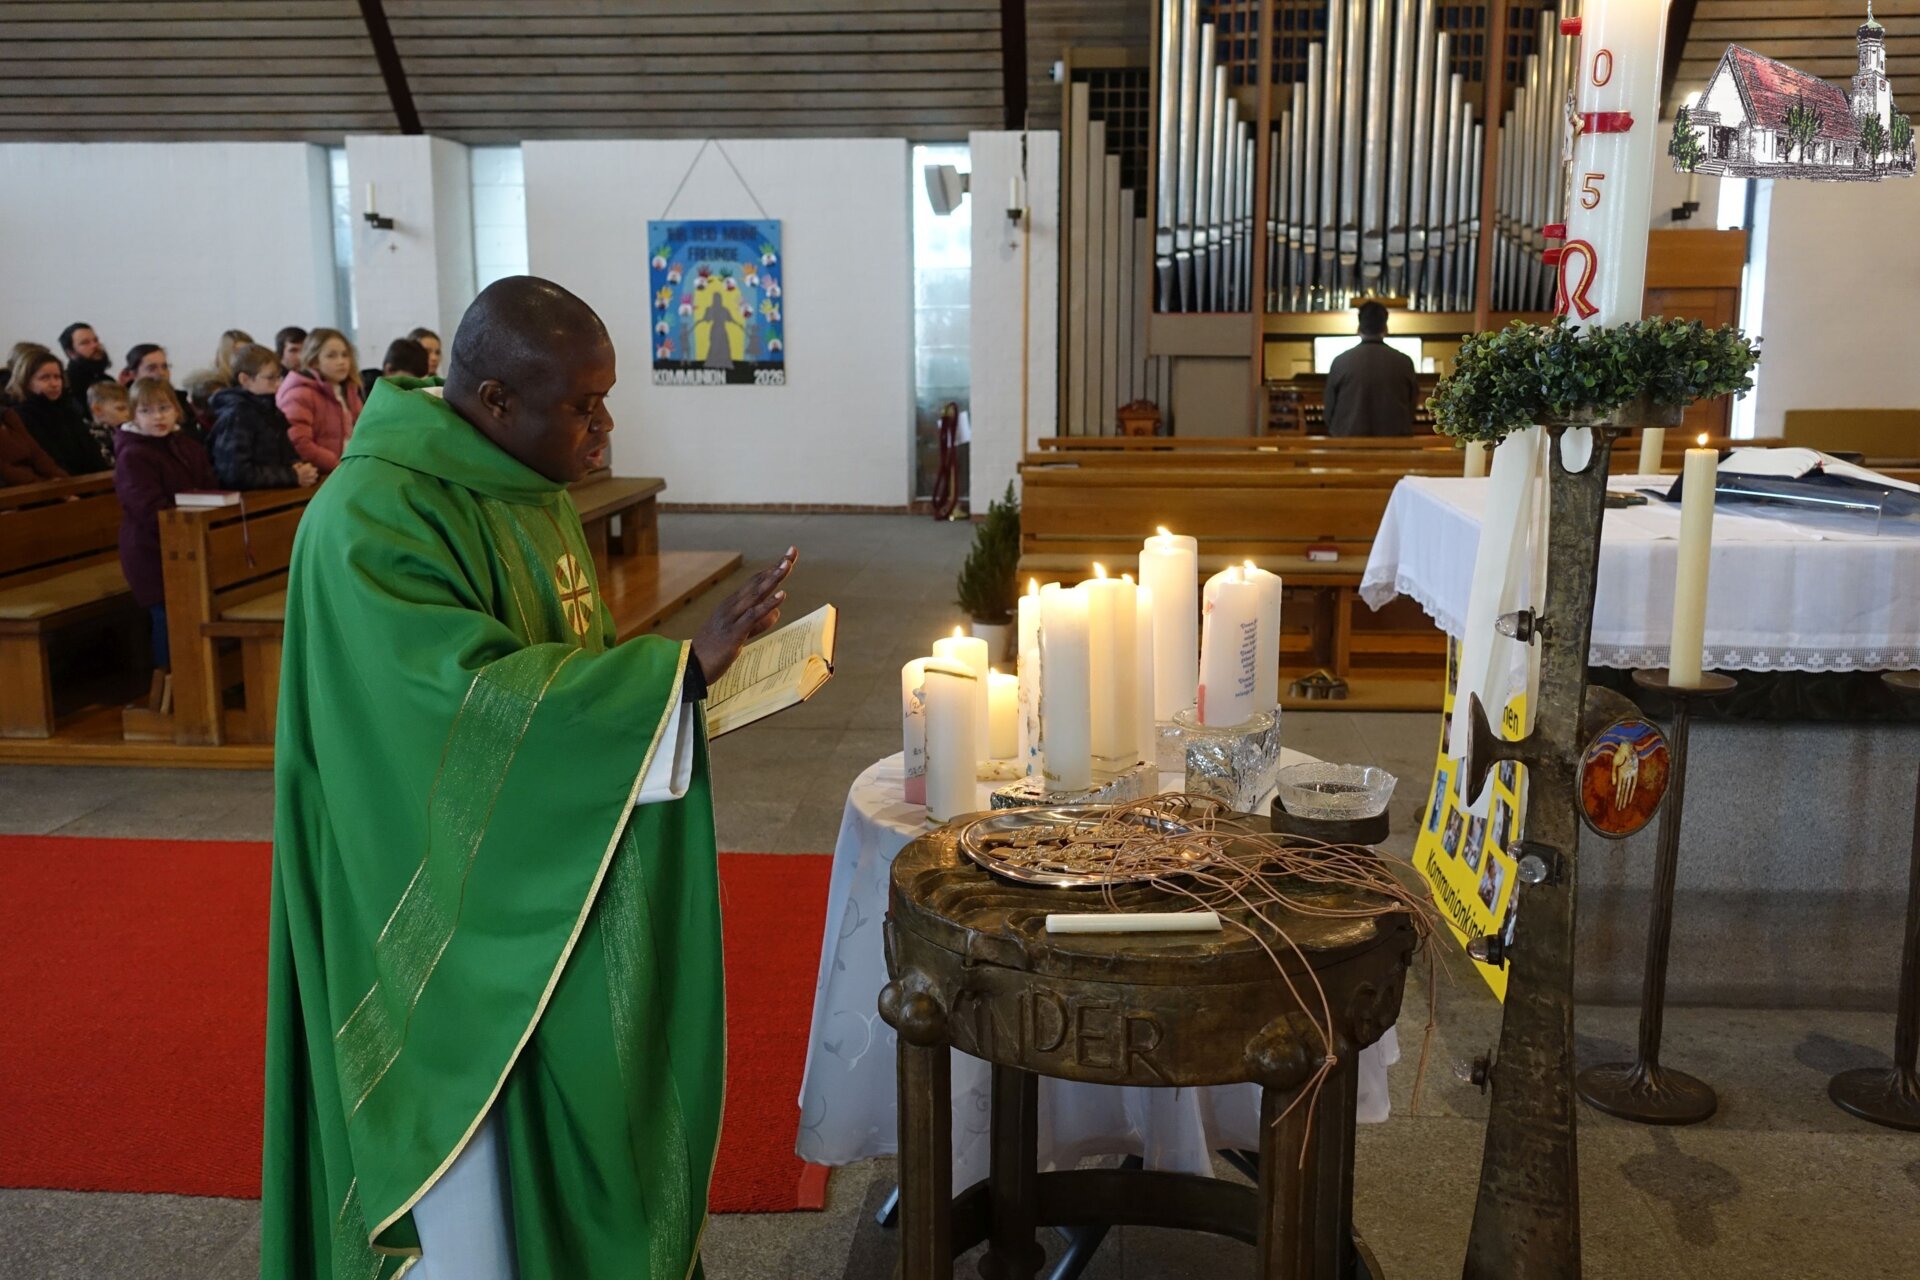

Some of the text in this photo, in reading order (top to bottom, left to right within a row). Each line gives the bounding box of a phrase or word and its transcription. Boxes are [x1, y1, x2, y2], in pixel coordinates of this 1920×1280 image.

[1580, 173, 1605, 209] 5
[653, 368, 785, 385] KOMMUNION 2026
